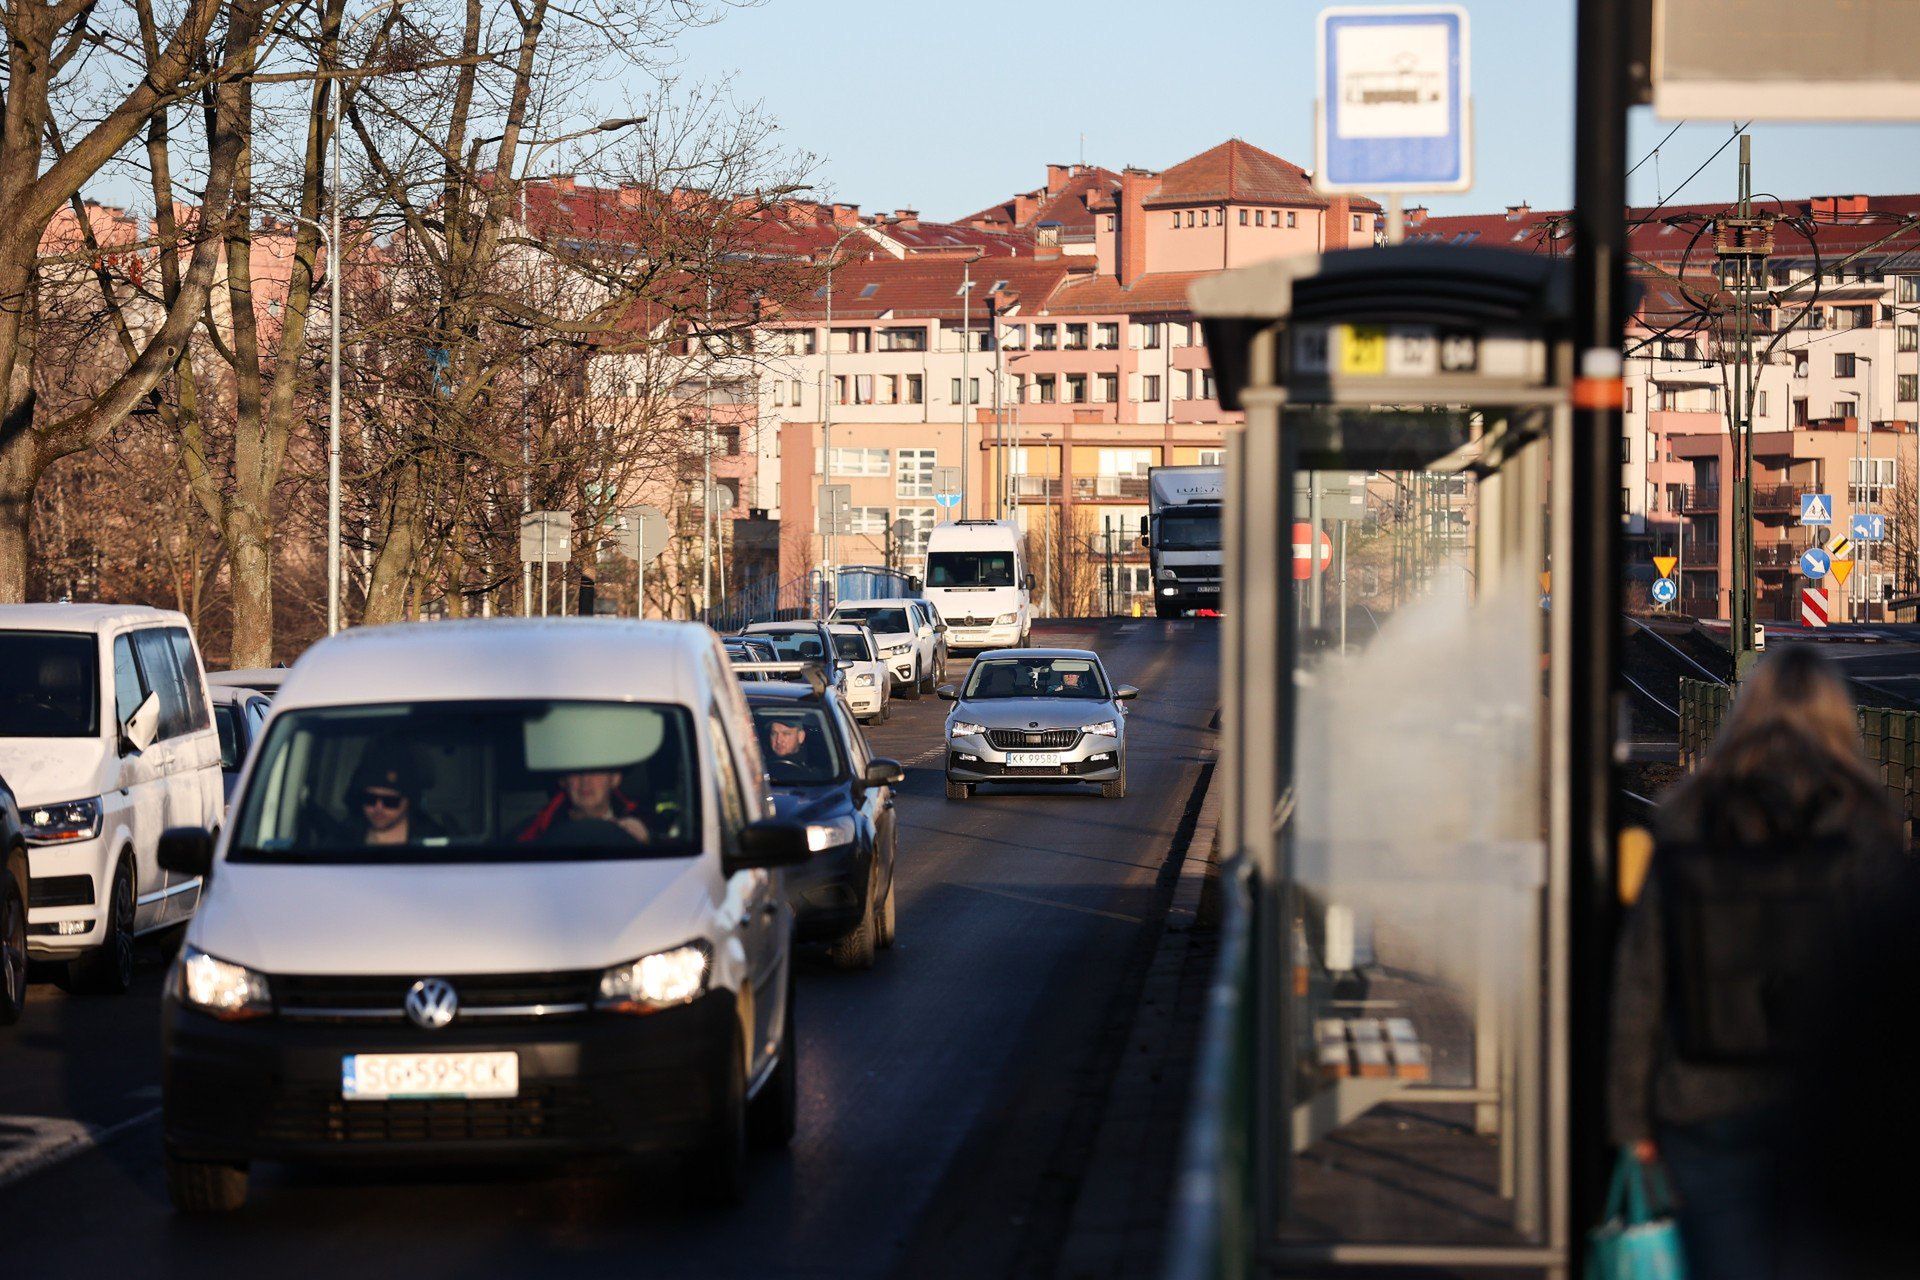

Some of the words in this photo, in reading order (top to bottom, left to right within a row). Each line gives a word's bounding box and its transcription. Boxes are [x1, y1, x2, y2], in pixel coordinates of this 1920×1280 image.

[1012, 754, 1025, 764] KK
[1028, 754, 1058, 764] 99582
[406, 979, 458, 1028] VW
[363, 1058, 402, 1089] SG
